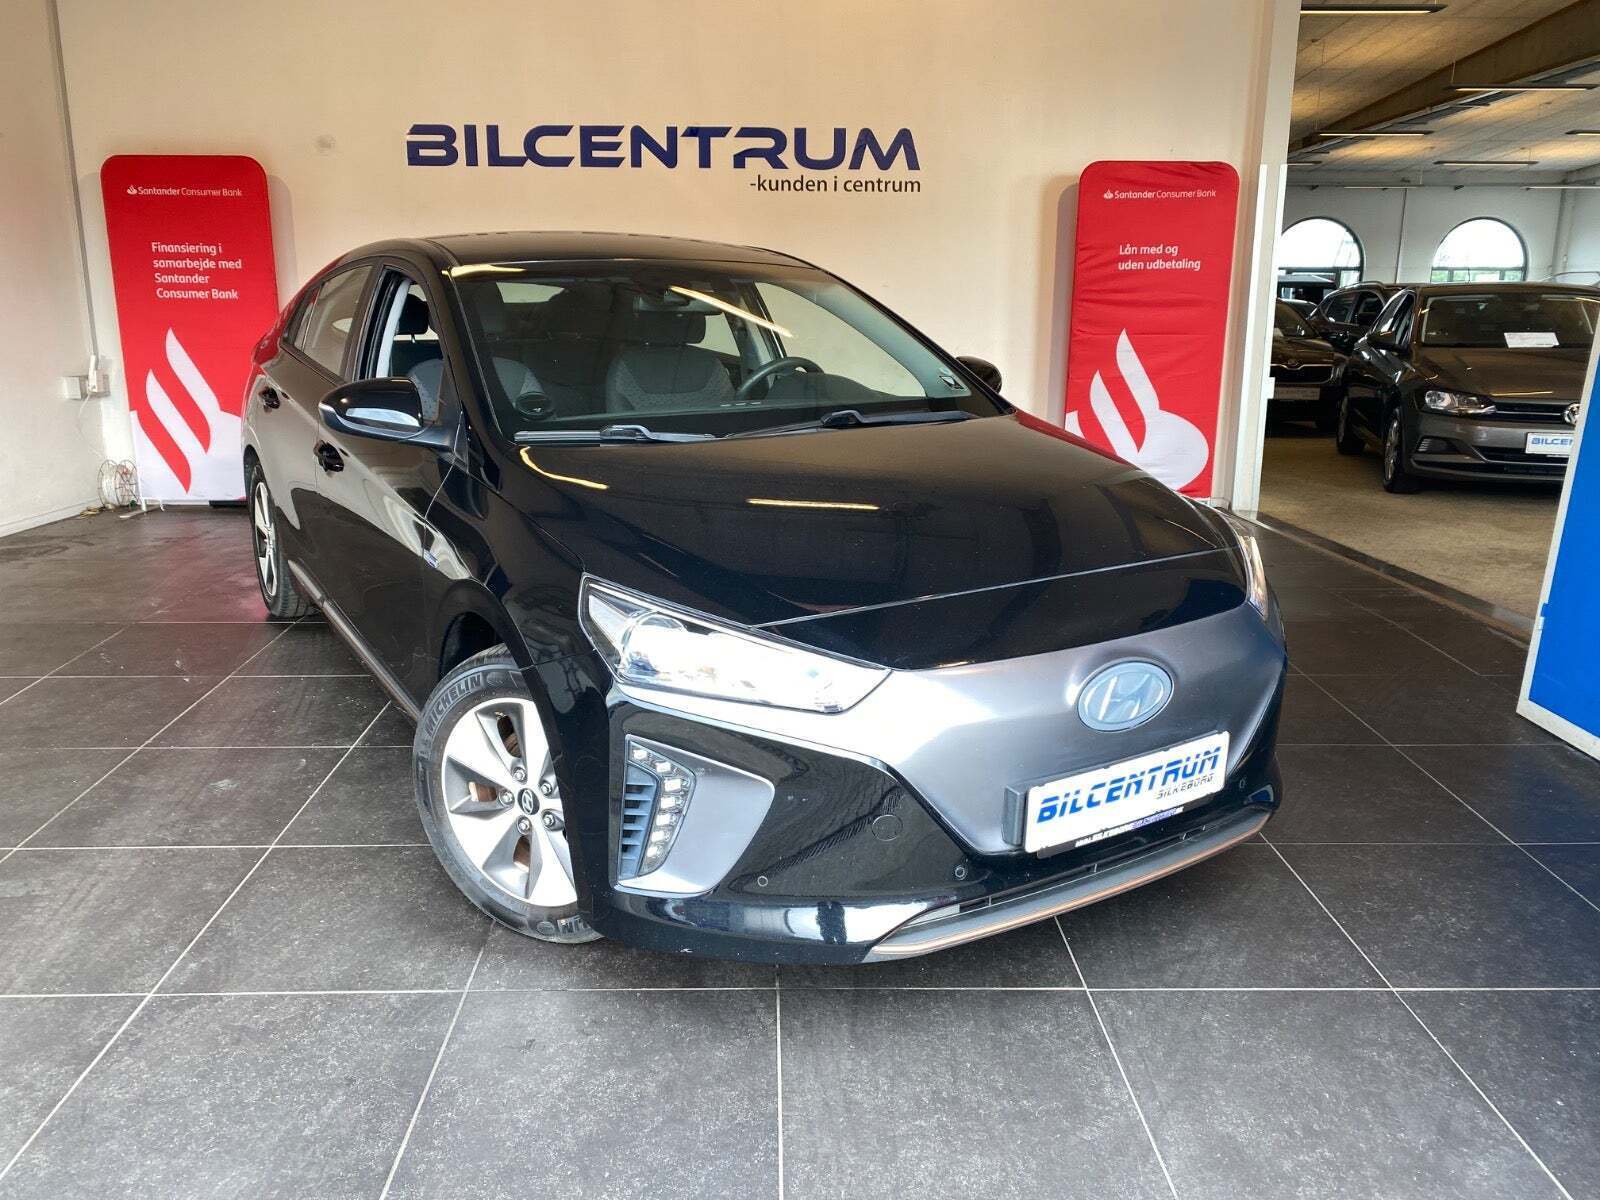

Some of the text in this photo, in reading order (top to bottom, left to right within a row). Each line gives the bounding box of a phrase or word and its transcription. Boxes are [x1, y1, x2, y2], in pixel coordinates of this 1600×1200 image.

[406, 123, 921, 171] BILCENTRUM
[750, 175, 921, 193] -kunden i centrum
[138, 187, 242, 197] Santander Consumer Bank
[1114, 189, 1216, 199] Santander Consumer Bank
[151, 242, 222, 256] Finansiering i
[1119, 243, 1178, 256] Lån med og
[153, 258, 242, 271] samarbejde med
[1118, 259, 1201, 271] uden udbetaling
[154, 273, 210, 284] Santander
[156, 288, 239, 300] Consumer Bank
[424, 675, 480, 736] MICHELIN
[1036, 746, 1222, 824] BILCENTRUM
